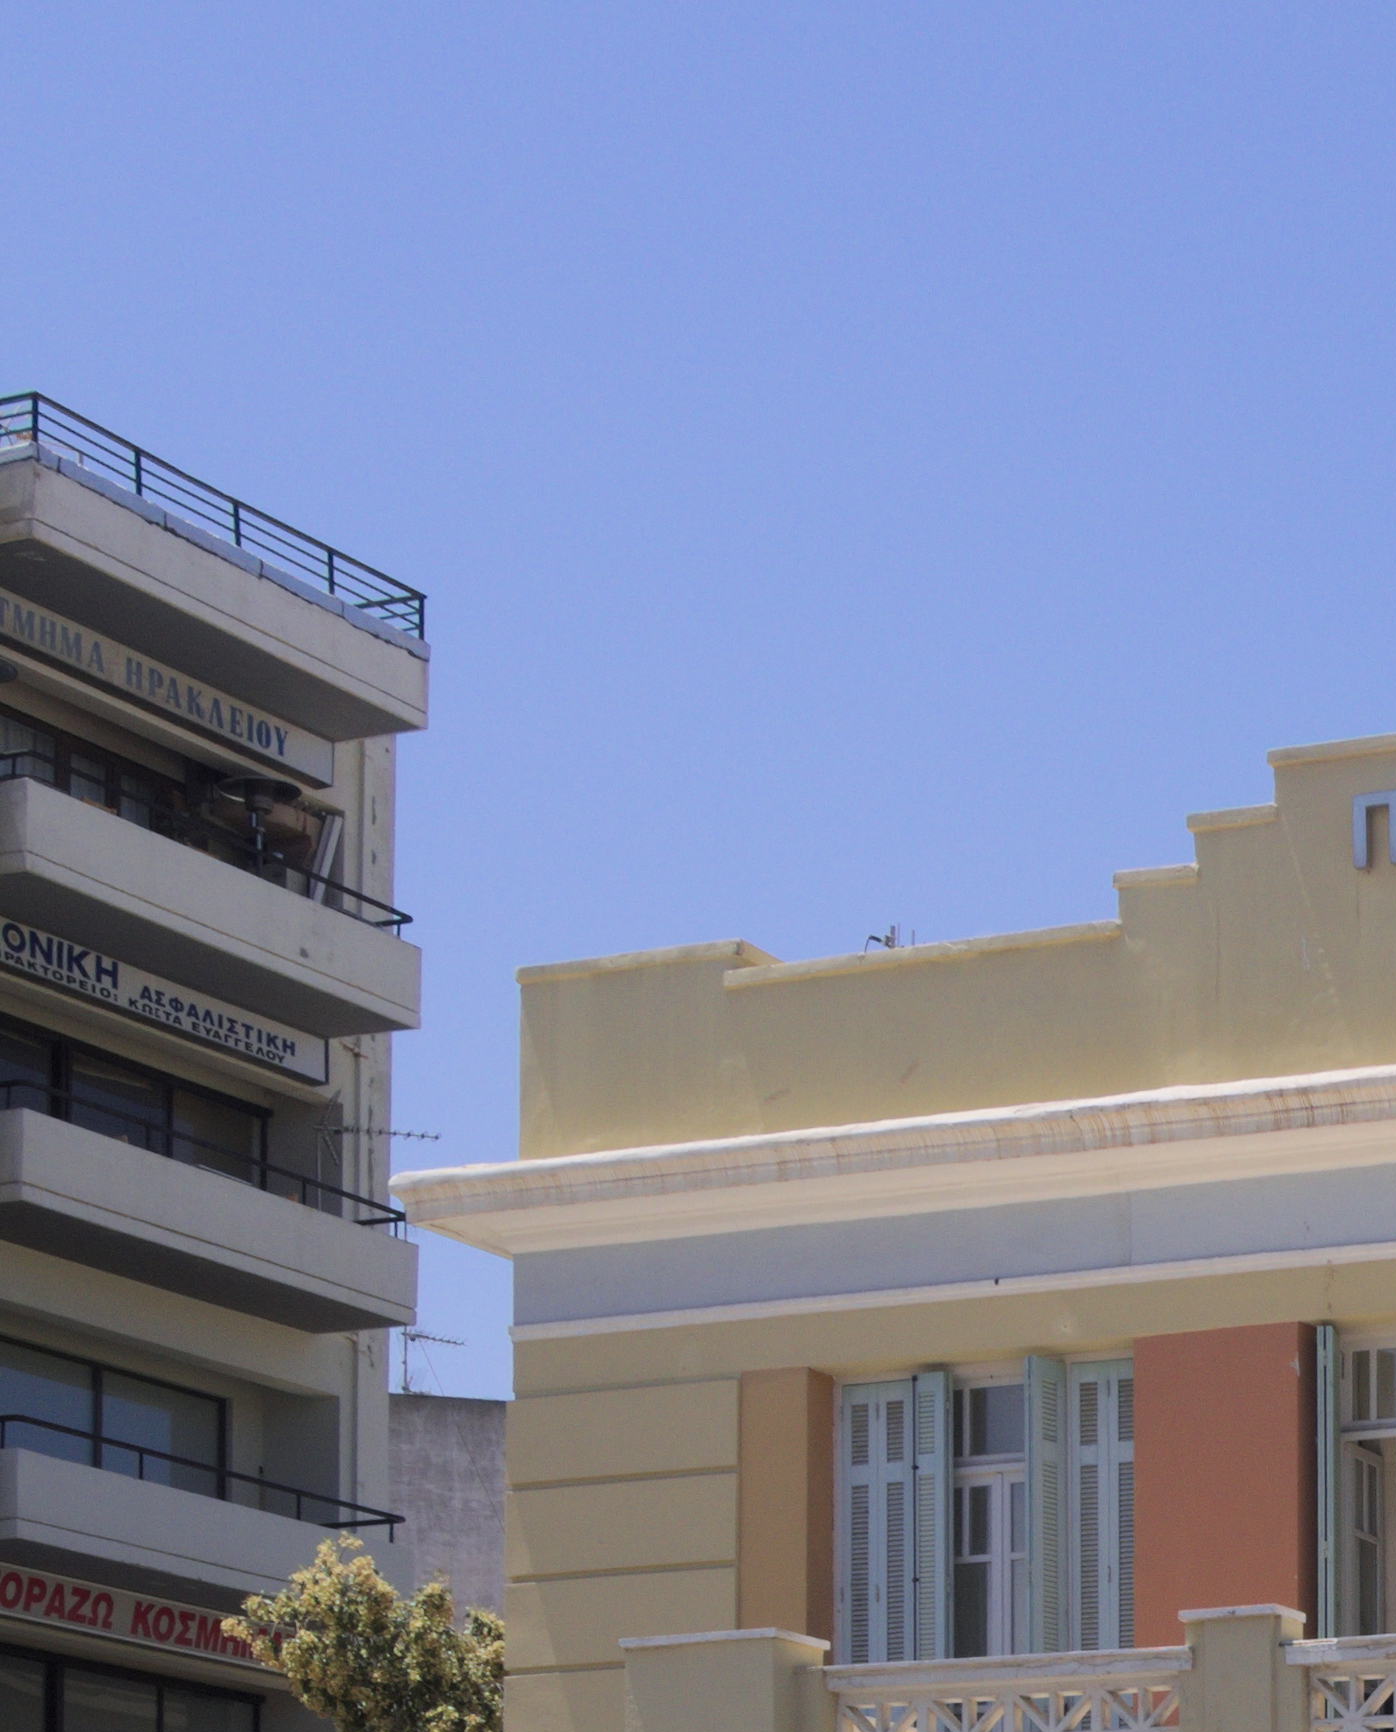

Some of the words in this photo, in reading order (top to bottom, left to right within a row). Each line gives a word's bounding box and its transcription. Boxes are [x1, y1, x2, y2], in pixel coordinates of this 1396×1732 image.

[125, 656, 289, 757] ΗΡΑΚΛΕΙΟΥ
[0, 951, 118, 1002] ΡΑΚΤΟΡΕΙΟ:
[128, 997, 183, 1027] ΚΩΣΤΑ
[191, 1020, 286, 1064] ΕΥΑΓΓΕΛΟΥ
[140, 985, 297, 1057] ΑΣΦΑΛΙΣΤΙΚΗ
[0, 1569, 114, 1630] ΟΡΑΖΩ
